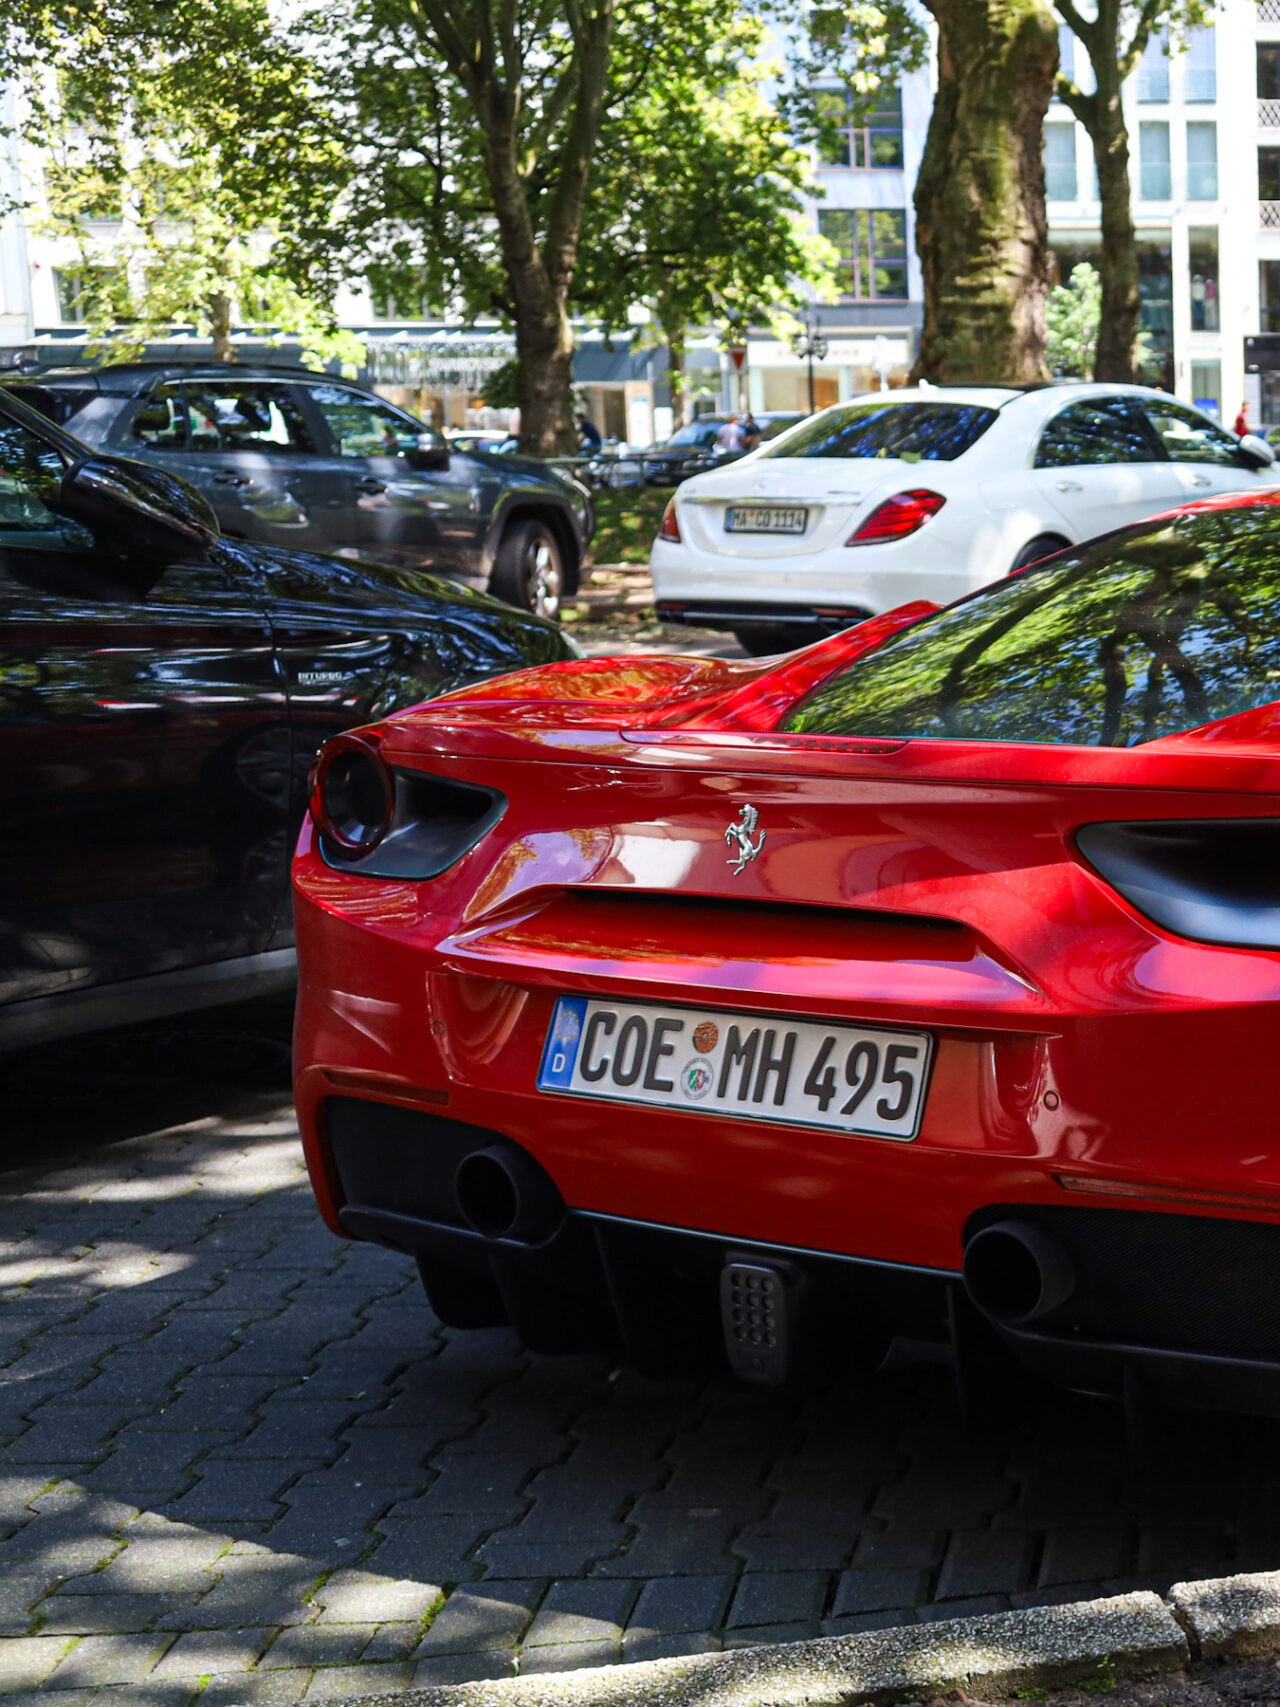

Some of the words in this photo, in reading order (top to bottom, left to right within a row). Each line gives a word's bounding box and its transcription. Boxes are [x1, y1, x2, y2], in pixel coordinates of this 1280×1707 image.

[733, 508, 747, 526] MA
[775, 511, 802, 528] 1114
[551, 1053, 565, 1073] D
[580, 1011, 684, 1092] COE
[717, 1025, 798, 1105] MH
[804, 1036, 918, 1121] 495
